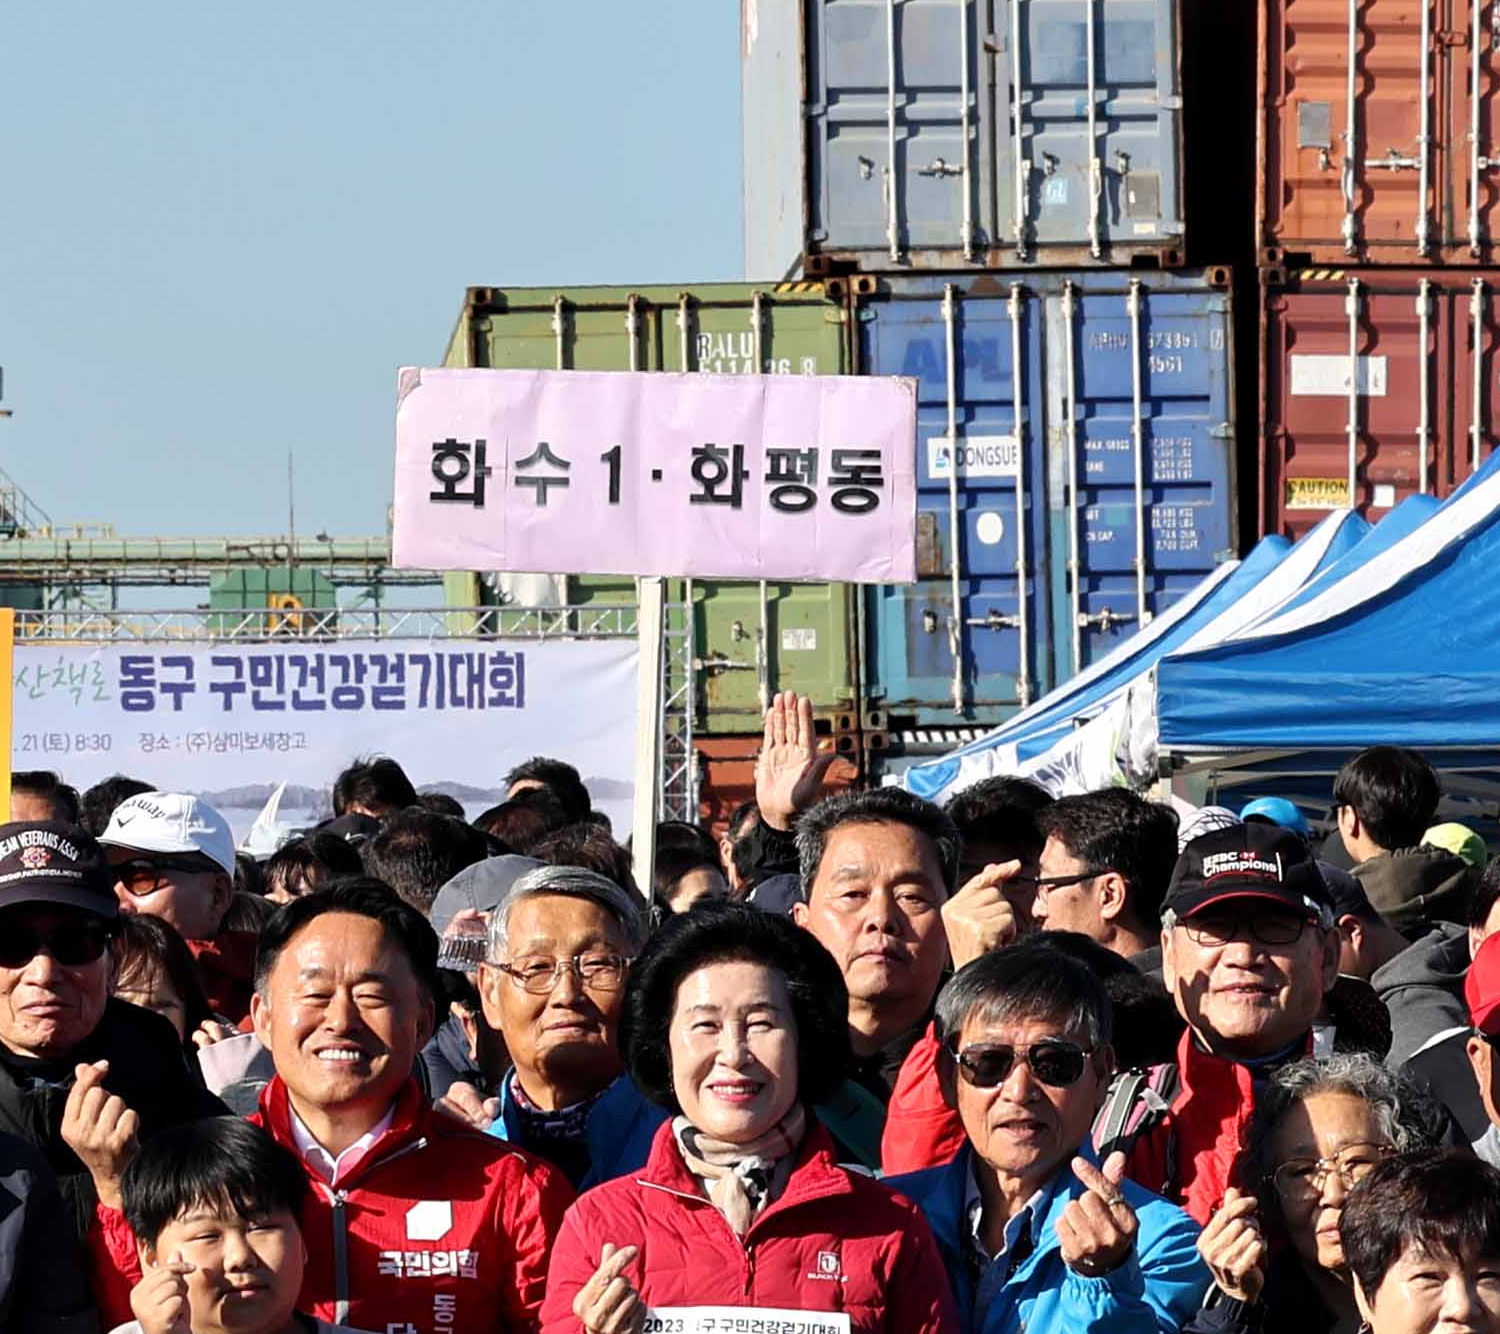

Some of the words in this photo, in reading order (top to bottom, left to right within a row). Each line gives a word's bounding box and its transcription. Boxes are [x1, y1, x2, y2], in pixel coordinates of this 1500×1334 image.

[696, 331, 754, 360] RALU
[1287, 479, 1349, 496] CAUTION
[118, 654, 197, 712] 동구
[208, 650, 526, 711] 구민건강걷기대회
[1203, 858, 1279, 879] Champions
[376, 1249, 480, 1281] 국민의힘
